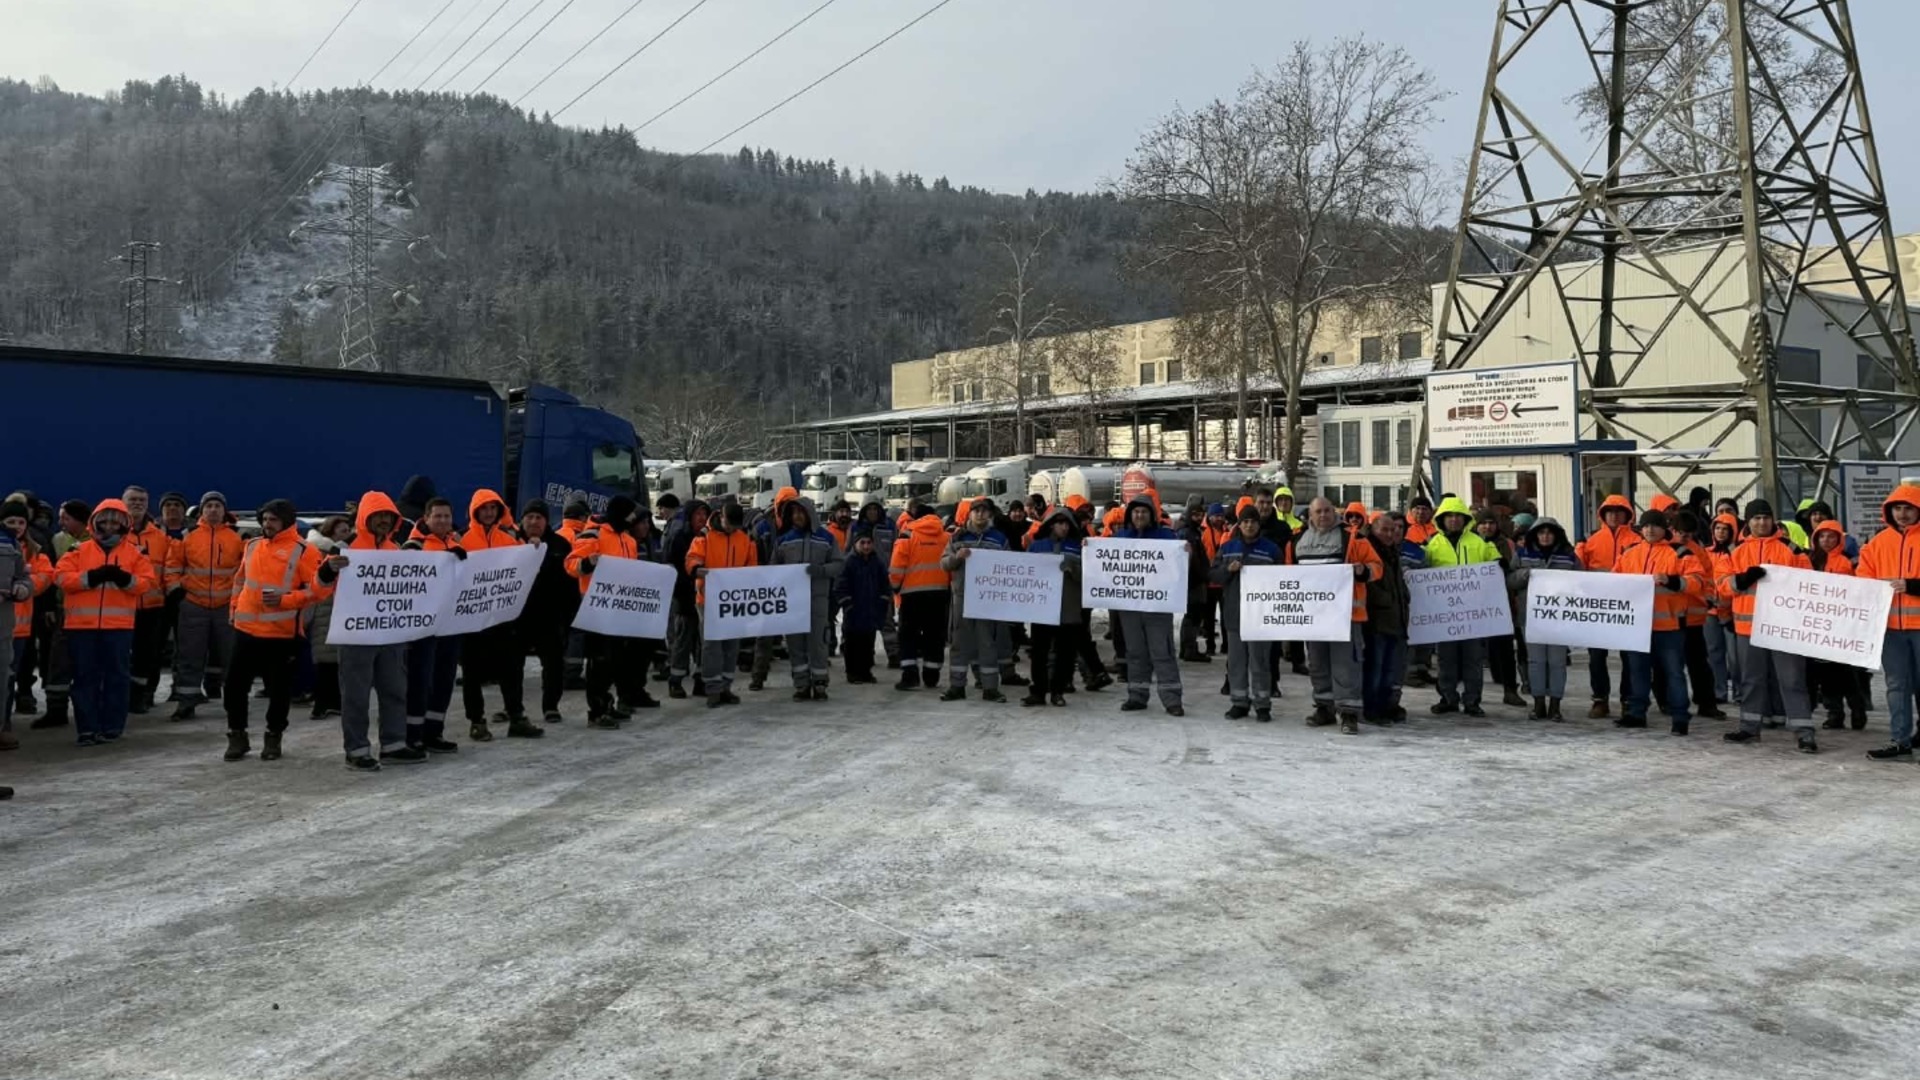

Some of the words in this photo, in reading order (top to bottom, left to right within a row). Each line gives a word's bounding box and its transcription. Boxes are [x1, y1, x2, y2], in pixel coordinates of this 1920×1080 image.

[1095, 549, 1120, 560] ЗАД
[1124, 550, 1165, 560] ВСЯКА
[356, 565, 387, 579] ЗАД
[390, 565, 437, 578] ВСЯКА
[992, 564, 1024, 575] ДНЕС
[1028, 566, 1036, 575] Е
[1102, 561, 1157, 574] МАШИНА
[1406, 569, 1457, 584] ИСКАМЕ
[1460, 568, 1478, 580] ДА
[1480, 565, 1496, 576] СЕ
[473, 567, 517, 585] НАШИТЕ
[975, 576, 1053, 591] КРОНОШПАН,
[1113, 575, 1145, 586] СТОИ
[363, 581, 427, 595] МАШИНА
[456, 587, 487, 604] ДЕЦА
[490, 580, 522, 596] СЪЩО
[595, 582, 615, 595] ТУК
[616, 585, 660, 601] ЖИВЕЕМ,
[1279, 580, 1300, 590] БЕЗ
[1426, 580, 1481, 596] ГРИЖИМ
[1799, 581, 1819, 595] НЕ
[1824, 585, 1847, 599] НИ
[719, 586, 787, 602] ОСТАВКА
[979, 591, 1008, 601] УТРЕ
[1010, 592, 1035, 603] КОЙ
[1090, 586, 1168, 601] СЕМЕЙСТВО!
[1246, 592, 1335, 602] ПРОИЗВОДСТВО
[1447, 596, 1464, 607] ЗА
[376, 598, 413, 612] СТОИ
[455, 600, 494, 616] РАСТАТ
[496, 595, 517, 609] ТУК!
[589, 596, 611, 608] ТУК
[611, 598, 661, 614] РАБОТИМ!
[719, 600, 788, 618] РИОСВ
[1272, 604, 1304, 613] НЯМА
[1535, 595, 1560, 606] ТУК
[1565, 596, 1634, 613] ЖИВЕЕМ,
[1774, 595, 1869, 621] ОСТАВЯЙТЕ
[344, 613, 437, 630] СЕМЕЙСТВО!
[1263, 616, 1313, 626] БЪДЕЩЕ!
[1410, 607, 1503, 626] СЕМЕЙСТВАТА
[1533, 608, 1558, 620] ТУК
[1562, 610, 1634, 626] РАБОТИМ!
[1802, 615, 1833, 631] БЕЗ
[1760, 623, 1865, 653] ПРЕПИТАНИЕ
